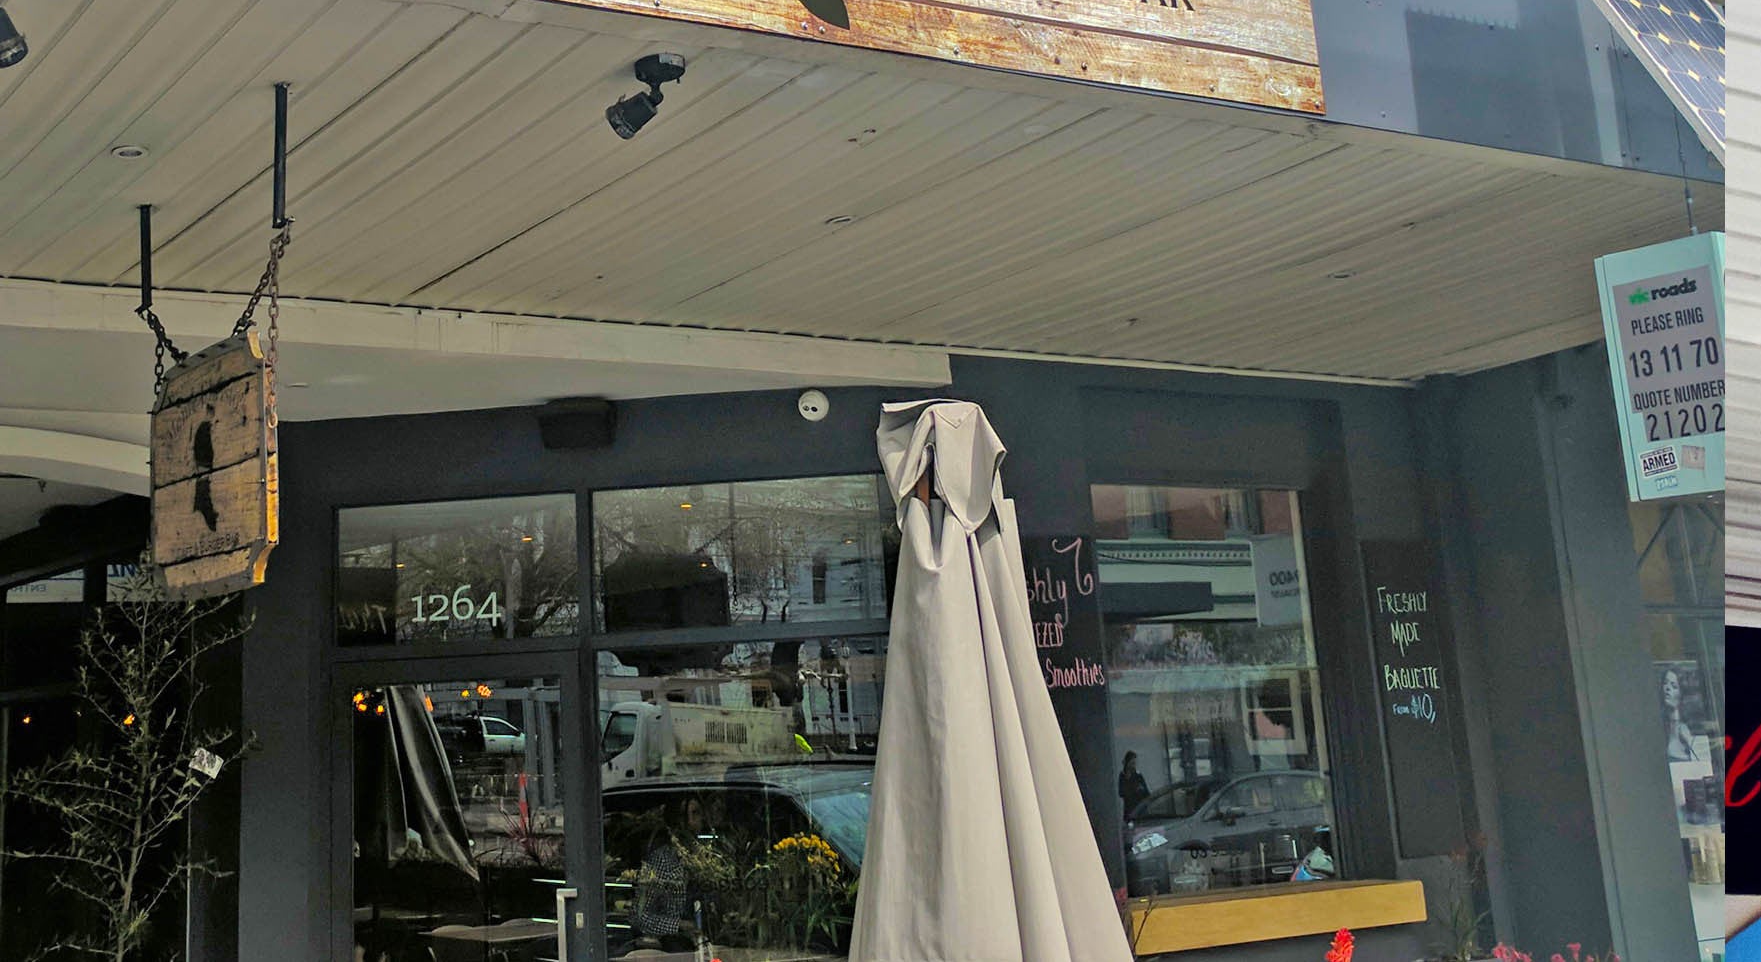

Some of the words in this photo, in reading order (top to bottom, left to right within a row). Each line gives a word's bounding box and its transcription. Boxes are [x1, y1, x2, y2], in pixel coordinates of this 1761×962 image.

[1631, 313, 1673, 336] PLEASE
[1675, 307, 1704, 326] RING
[1629, 350, 1654, 378] 13
[1660, 343, 1683, 372] 11
[1689, 337, 1719, 367] 70
[1633, 389, 1671, 411] QUOTE
[1674, 379, 1725, 404] NUMBER
[1643, 452, 1676, 472] ARMED
[411, 584, 502, 627] 1264
[1384, 664, 1440, 691] BAGUETTE
